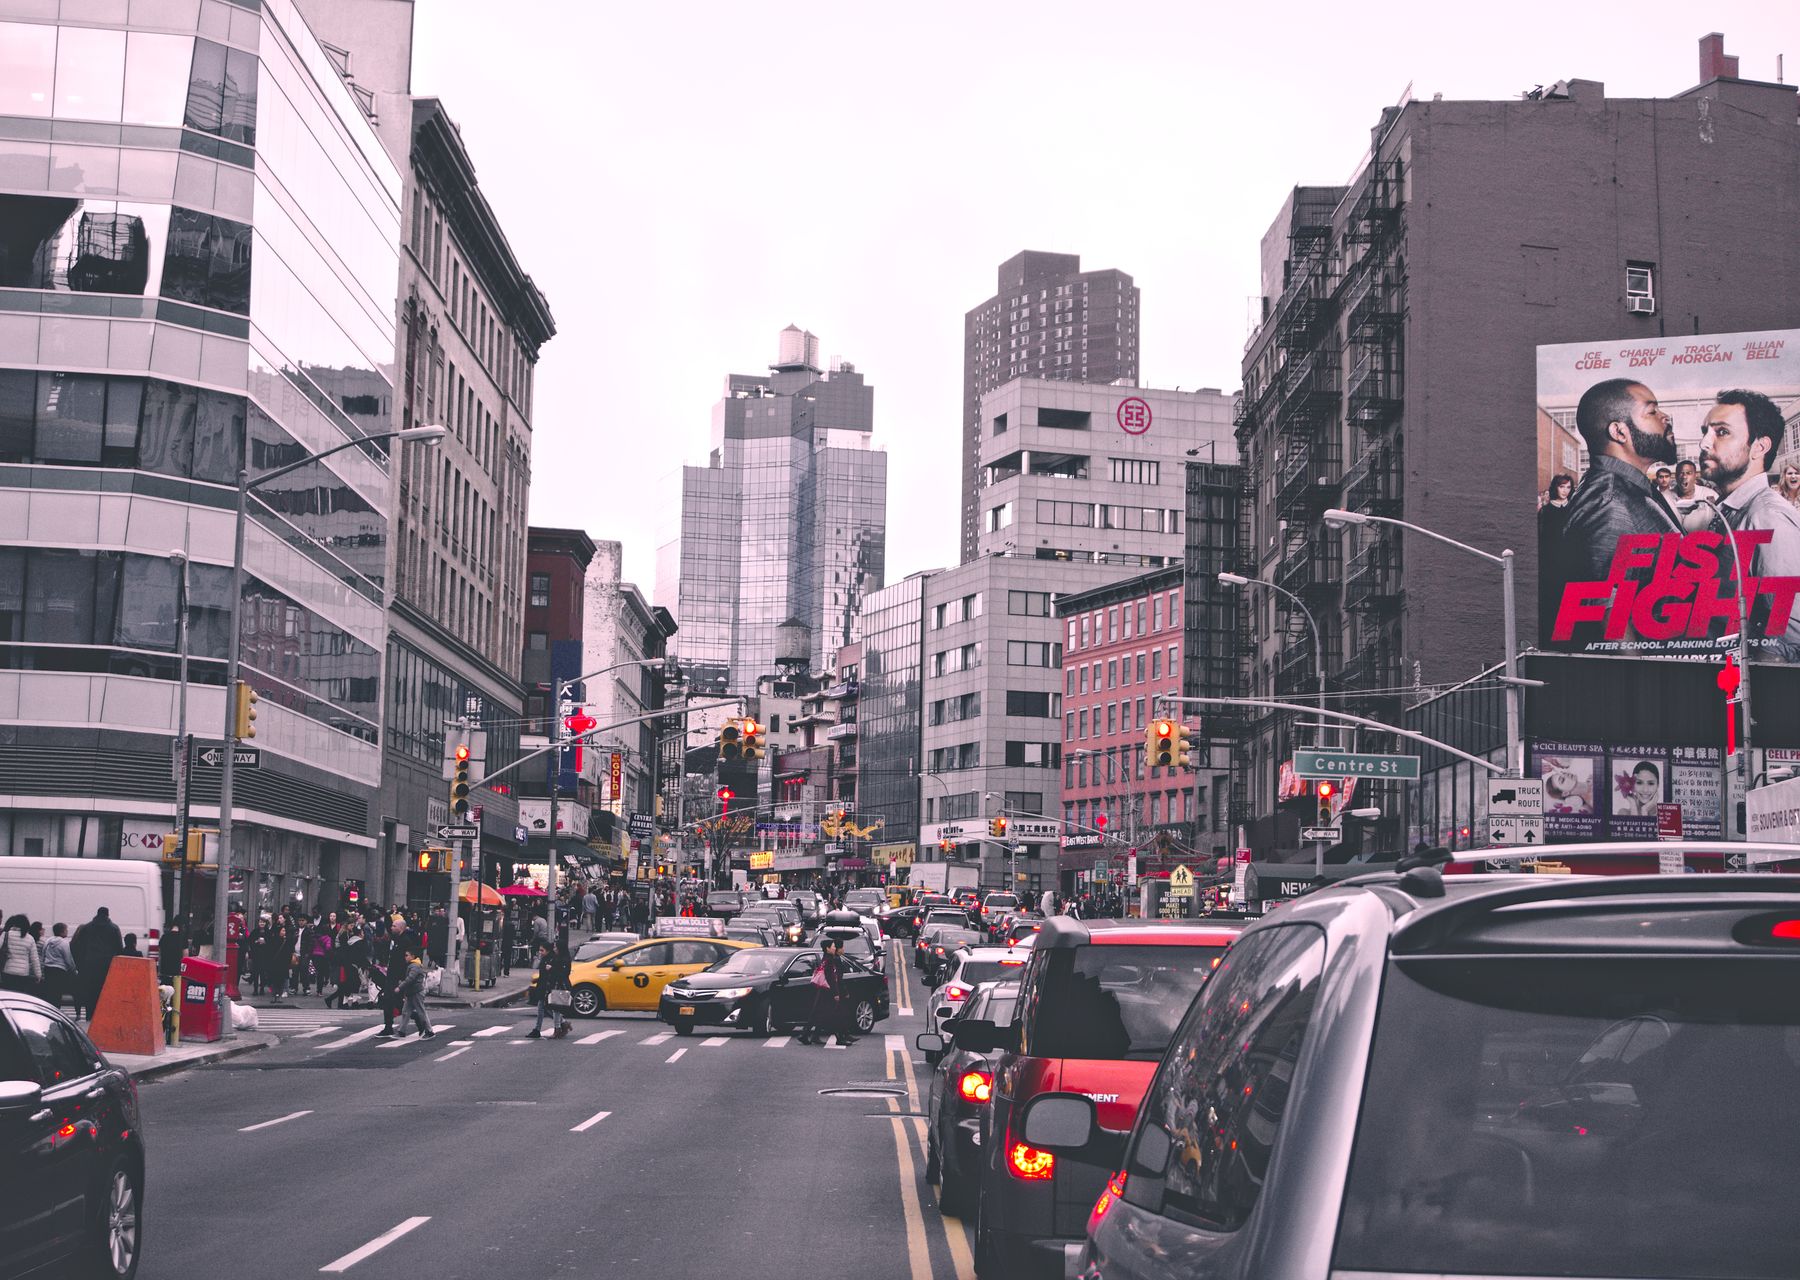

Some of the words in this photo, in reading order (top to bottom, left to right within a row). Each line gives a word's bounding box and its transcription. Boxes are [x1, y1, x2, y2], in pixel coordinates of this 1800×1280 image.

[1684, 344, 1721, 354] TRACY
[1742, 340, 1785, 351] JILLIAN
[1583, 351, 1601, 360] ICE
[1619, 348, 1667, 358] CHARLIE
[1671, 351, 1733, 365] MORGAN
[1746, 350, 1780, 360] BELL
[1575, 358, 1612, 370] CUBE
[1628, 356, 1657, 367] DAY
[1606, 529, 1775, 586] FIST
[1551, 575, 1800, 642] FIGHT
[1585, 640, 1618, 651] AFTER
[1620, 639, 1665, 650] SCHOOL.
[1667, 638, 1713, 649] PARKING
[1715, 638, 1737, 648] LOT.
[1761, 638, 1780, 646] ON.
[1557, 743, 1588, 752] BEAUTY
[206, 753, 224, 761] ONE
[1768, 749, 1788, 760] CELL
[1315, 758, 1374, 772] Centre
[1379, 761, 1398, 773] St
[612, 762, 620, 791] GOLD
[1518, 787, 1540, 795] TRUCK
[1518, 800, 1540, 808] ROUTE
[1491, 819, 1513, 827] LOCAL
[121, 832, 139, 848] BC
[1732, 857, 1746, 865] ONE
[1281, 882, 1311, 895] NEW
[638, 975, 645, 986] T
[187, 985, 206, 997] am
[1082, 1093, 1119, 1103] MENT
